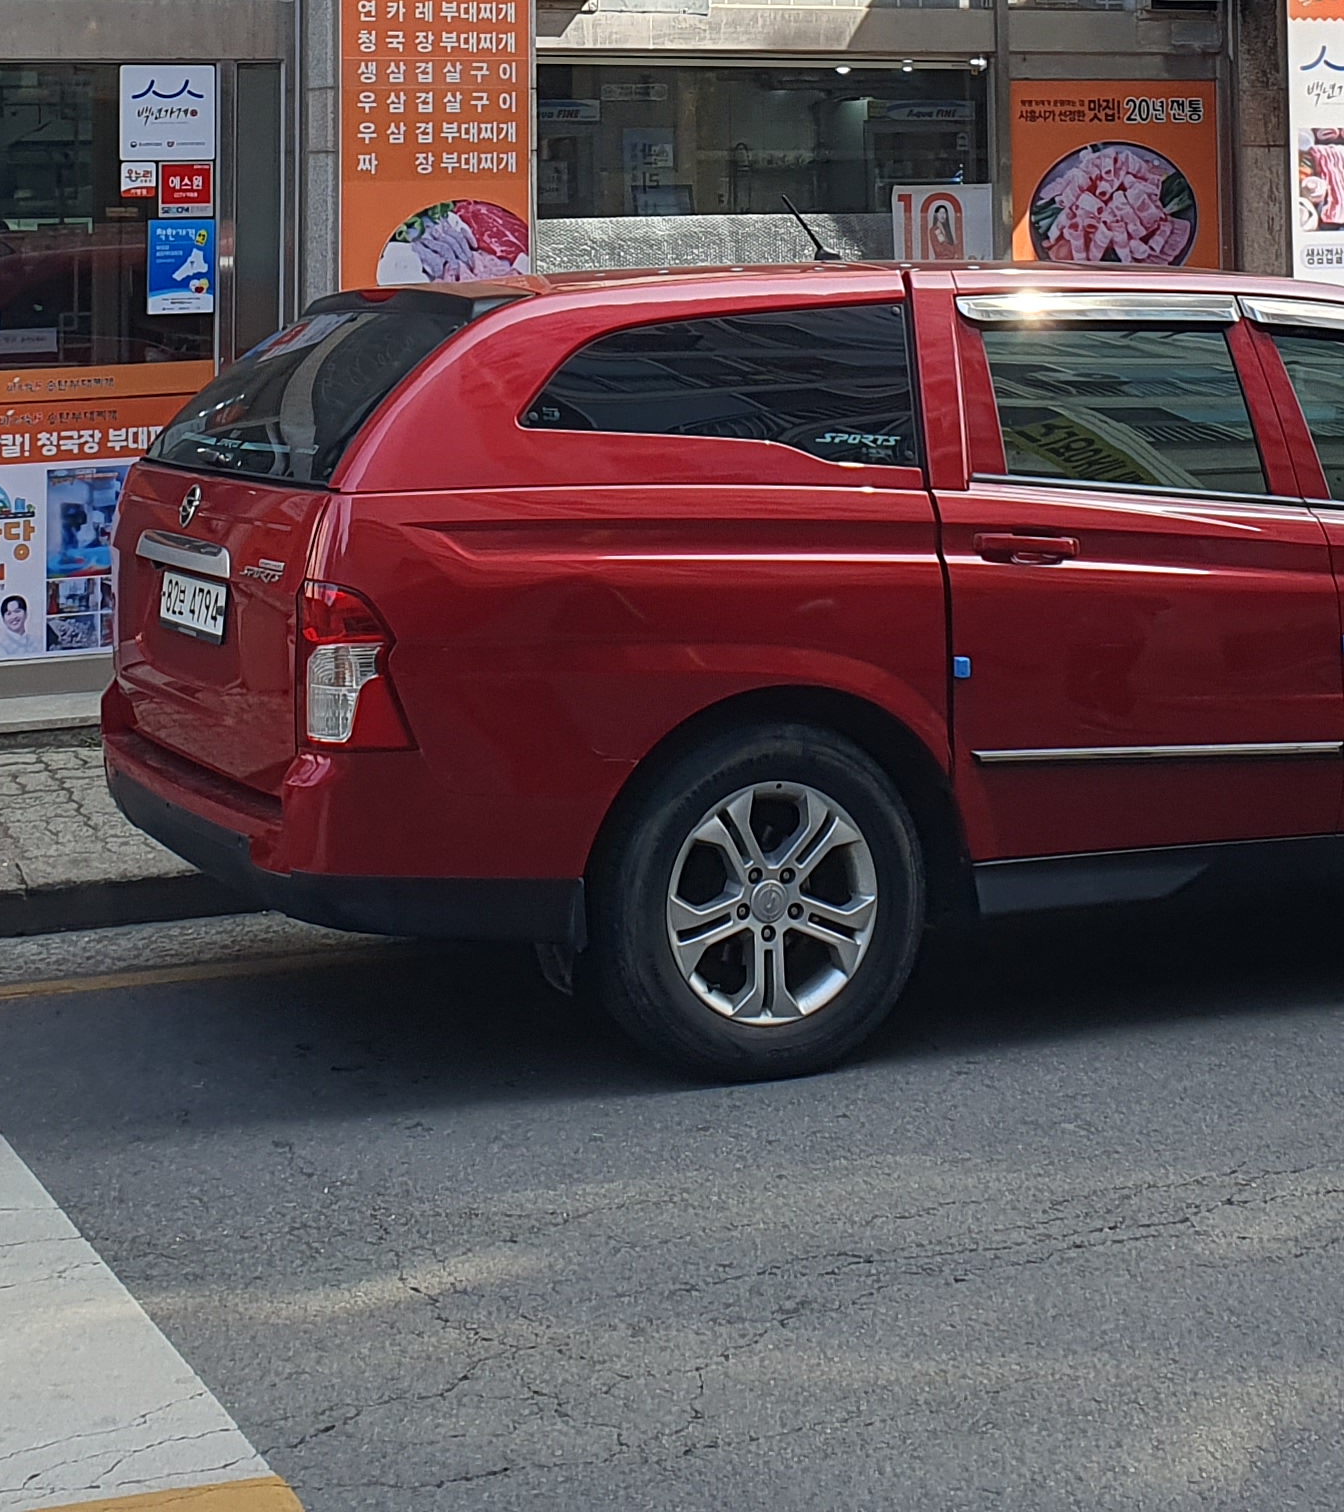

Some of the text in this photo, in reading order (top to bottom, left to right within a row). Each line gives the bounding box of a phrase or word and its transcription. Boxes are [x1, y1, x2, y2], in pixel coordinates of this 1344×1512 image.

[439, 2, 516, 25] 부대찌개
[357, 31, 516, 55] 청국장 부대찌개
[1018, 110, 1056, 122] 시흥시가
[1088, 99, 1121, 122] 맛집!
[1124, 98, 1165, 123] 20년
[1169, 99, 1203, 123] 전통
[440, 122, 517, 144] 부대찌개
[440, 152, 517, 174] 부대찌개
[169, 176, 203, 190] 에스원
[1306, 249, 1343, 264] 생삼겹살
[37, 430, 102, 455] 청국장
[815, 433, 901, 447] SPORTS
[189, 584, 219, 628] 4794
